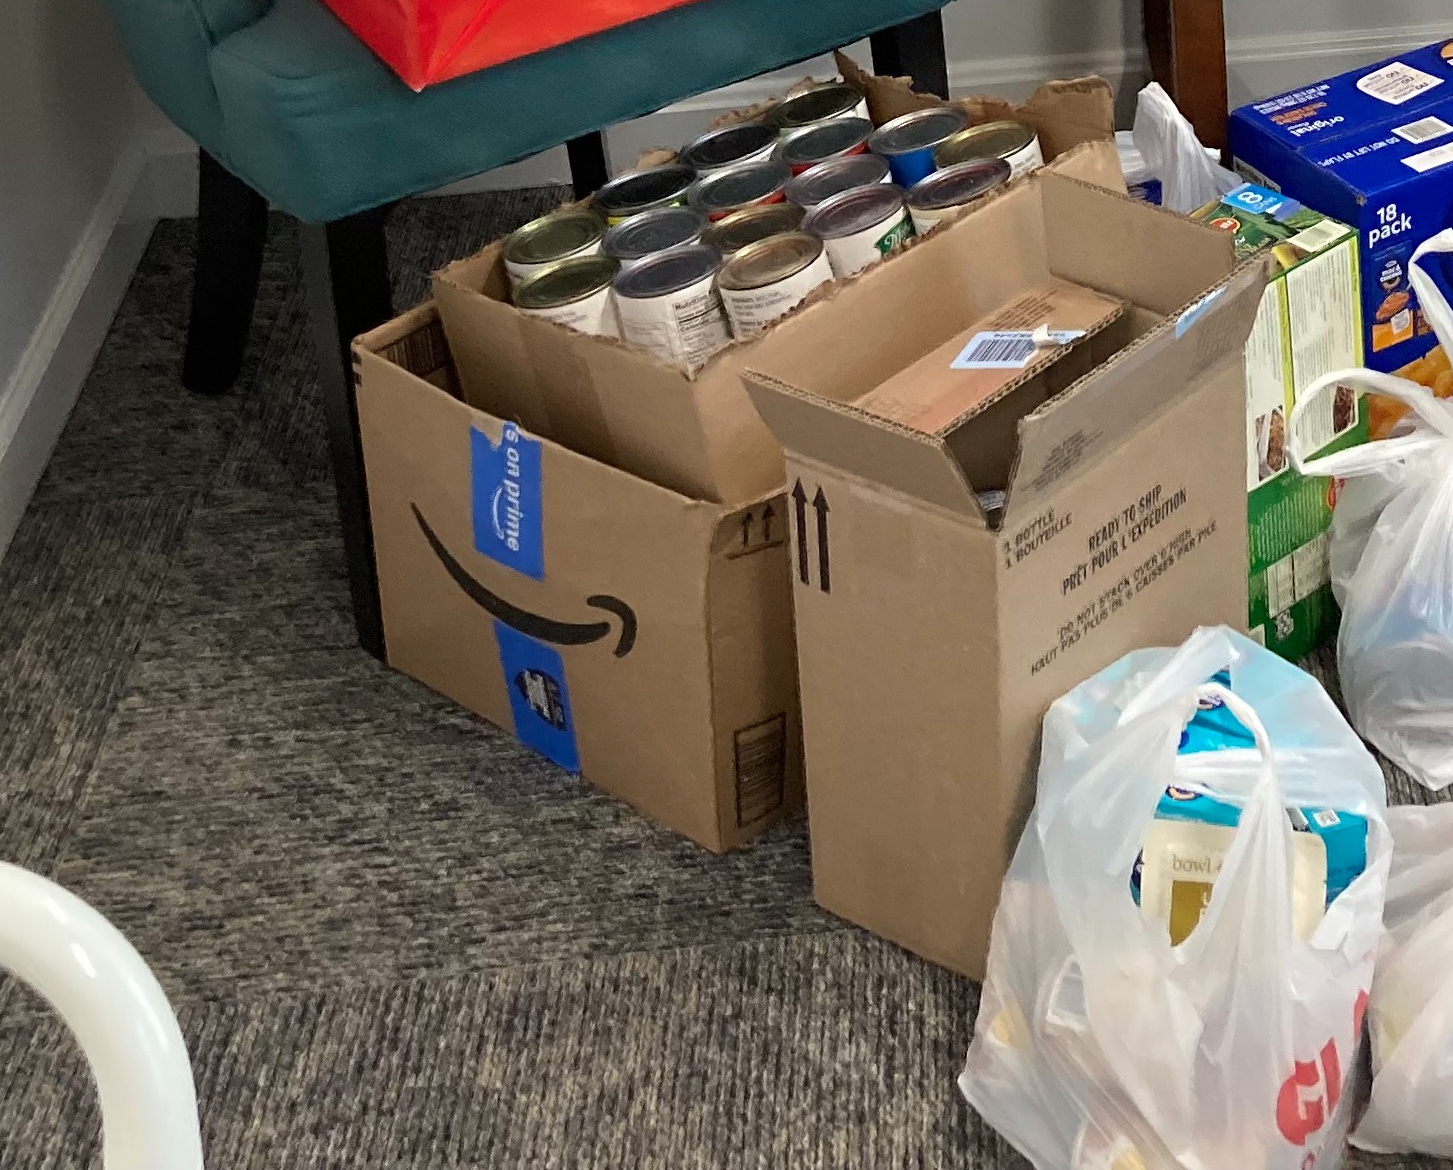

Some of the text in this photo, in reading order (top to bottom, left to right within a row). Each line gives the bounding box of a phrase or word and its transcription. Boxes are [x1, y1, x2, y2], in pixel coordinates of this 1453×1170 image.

[1290, 116, 1345, 137] original
[1238, 191, 1263, 204] 8
[1376, 203, 1397, 224] 18
[1369, 212, 1412, 248] pack
[505, 447, 521, 478] on
[502, 479, 524, 552] prime
[1015, 506, 1056, 548] BOTTLE
[1089, 483, 1163, 554] READY TO SHIP
[1016, 512, 1073, 563] BOUTEILLE
[1091, 539, 1120, 577] POUR
[1031, 645, 1059, 677] HAUT
[1060, 631, 1082, 653] PAS
[1084, 609, 1110, 636] PLUS
[1111, 597, 1125, 614] DE
[1135, 554, 1176, 595] CAISSES
[1177, 536, 1197, 559] PAR
[1060, 619, 1075, 640] DO
[1076, 601, 1097, 625] NOT
[1098, 576, 1132, 609] STACK
[1133, 552, 1160, 582] OVER
[1173, 855, 1212, 873] bowl
